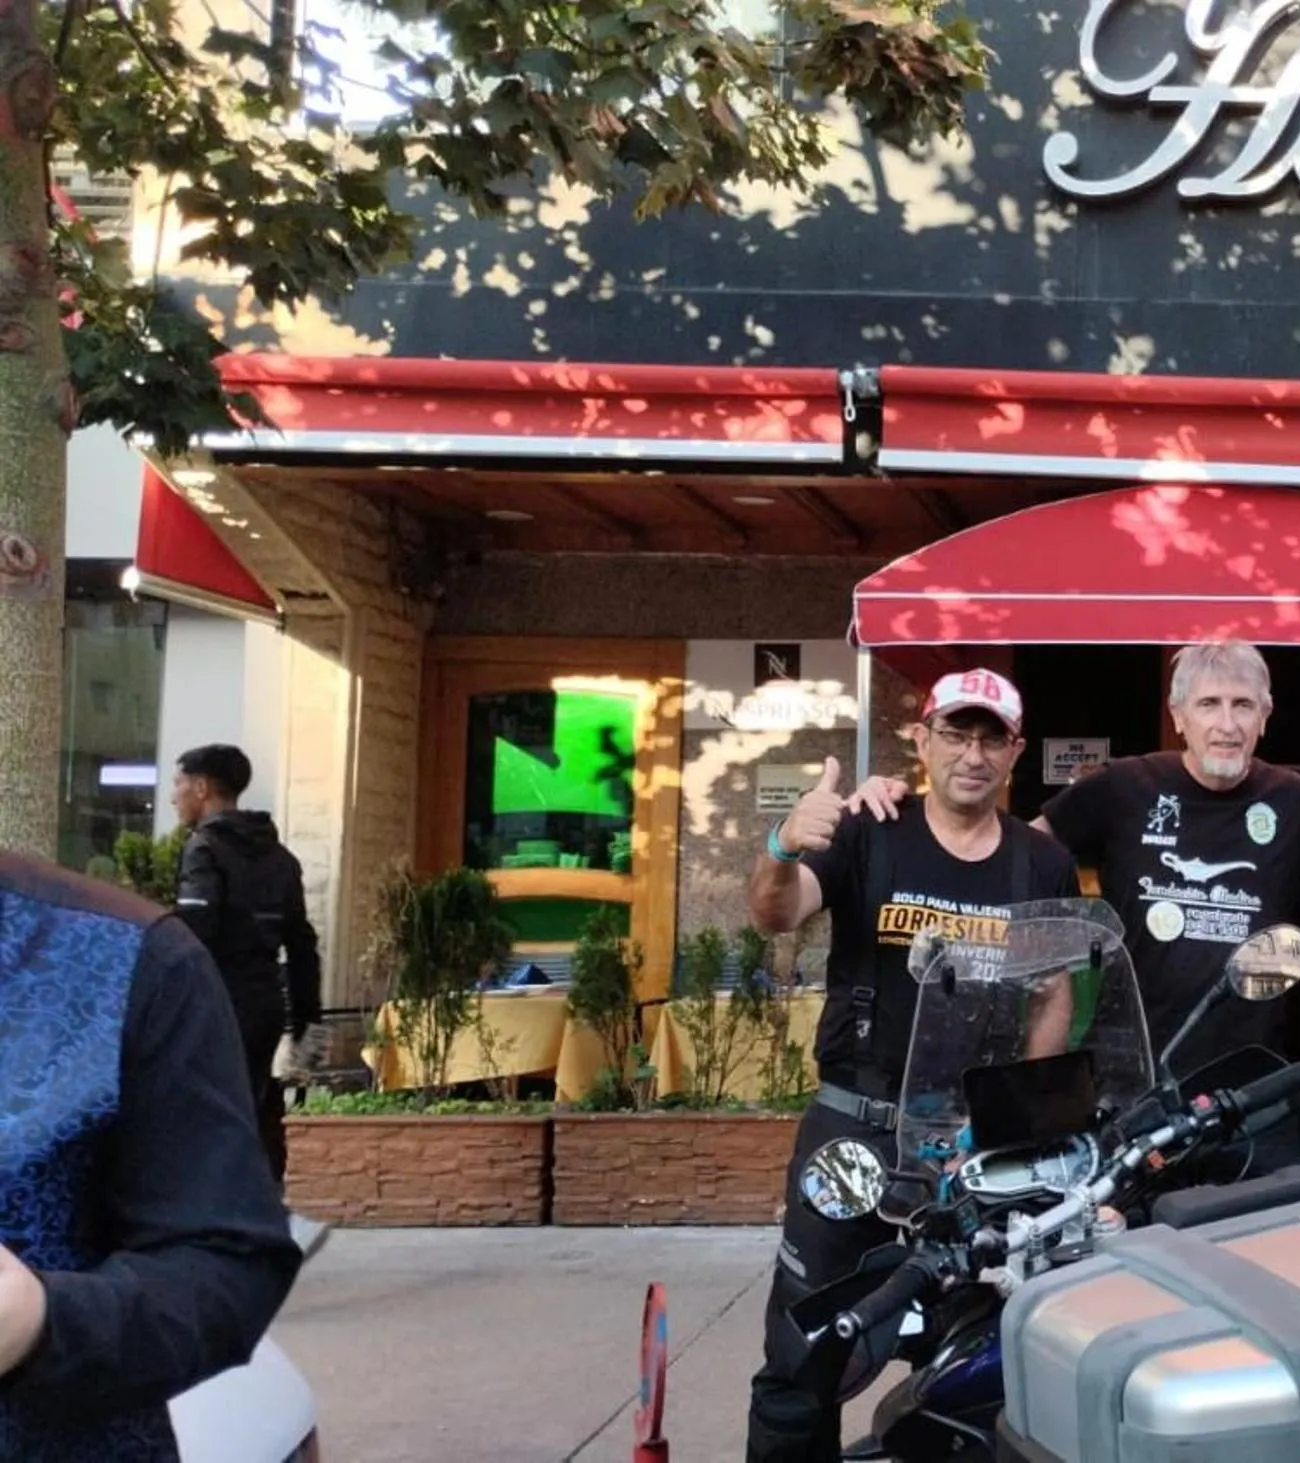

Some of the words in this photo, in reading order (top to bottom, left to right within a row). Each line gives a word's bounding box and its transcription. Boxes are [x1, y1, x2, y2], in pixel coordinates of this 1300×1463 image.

[891, 892, 926, 907] SOLO
[926, 896, 958, 914] PARA
[949, 944, 1008, 963] INVERN
